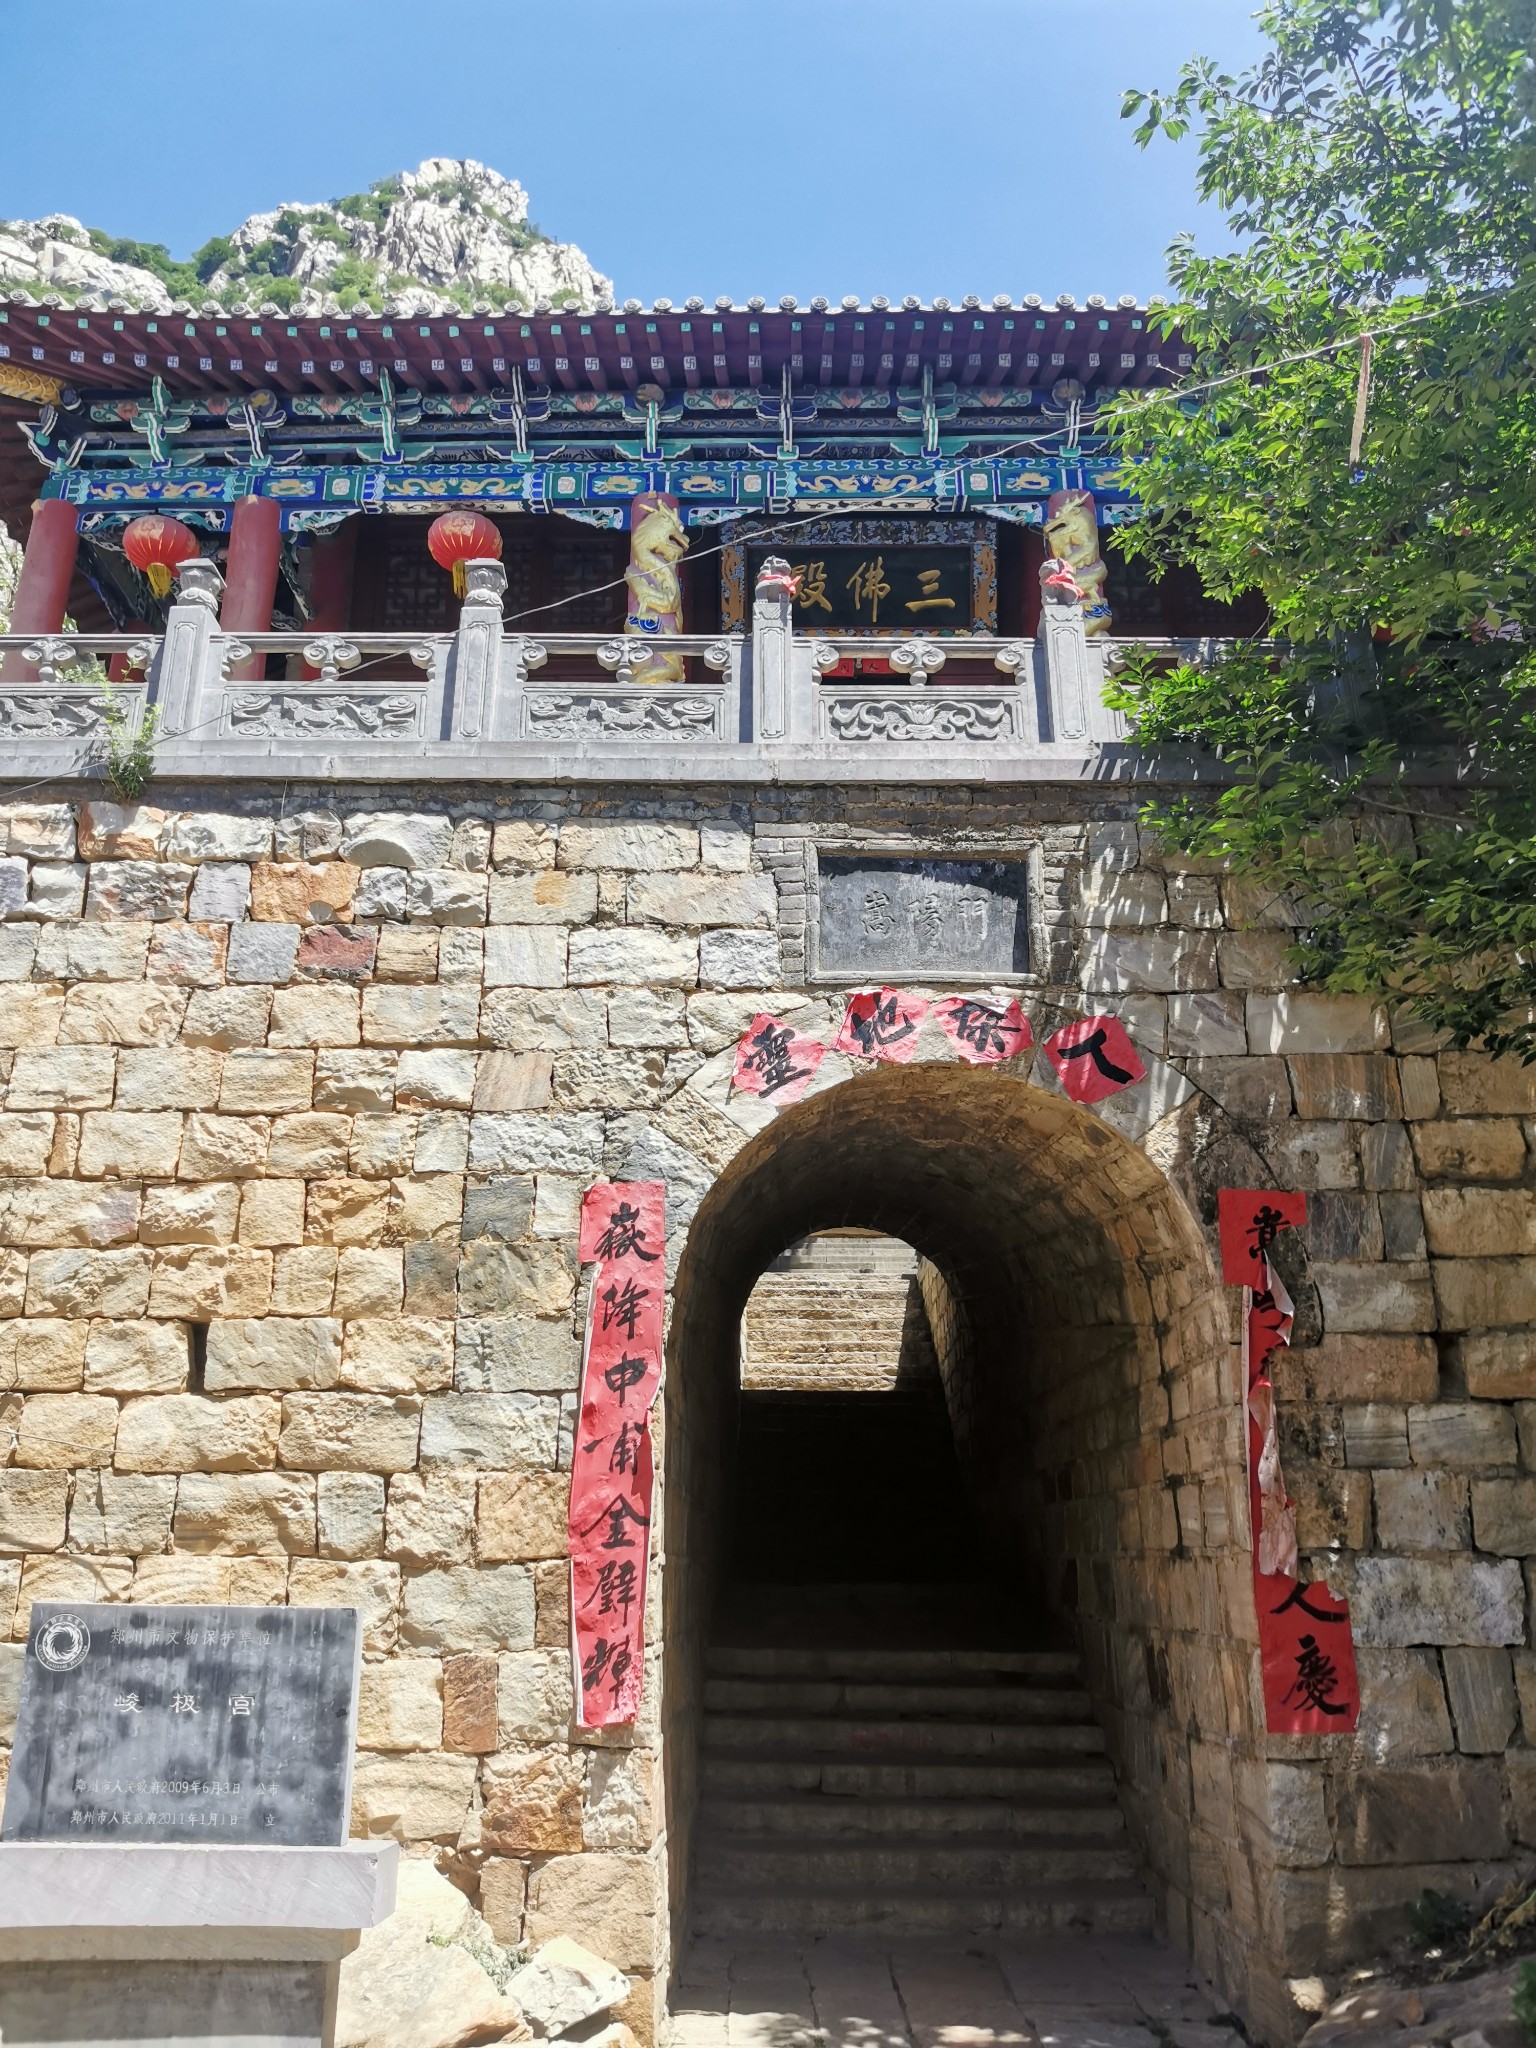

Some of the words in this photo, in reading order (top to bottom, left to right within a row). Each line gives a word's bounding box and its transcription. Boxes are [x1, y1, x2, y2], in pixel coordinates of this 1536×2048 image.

[861, 890, 989, 948] 嵩陽門
[110, 1628, 272, 1646] 郑州市文物保护单位
[113, 1692, 256, 1716] 峻极宫
